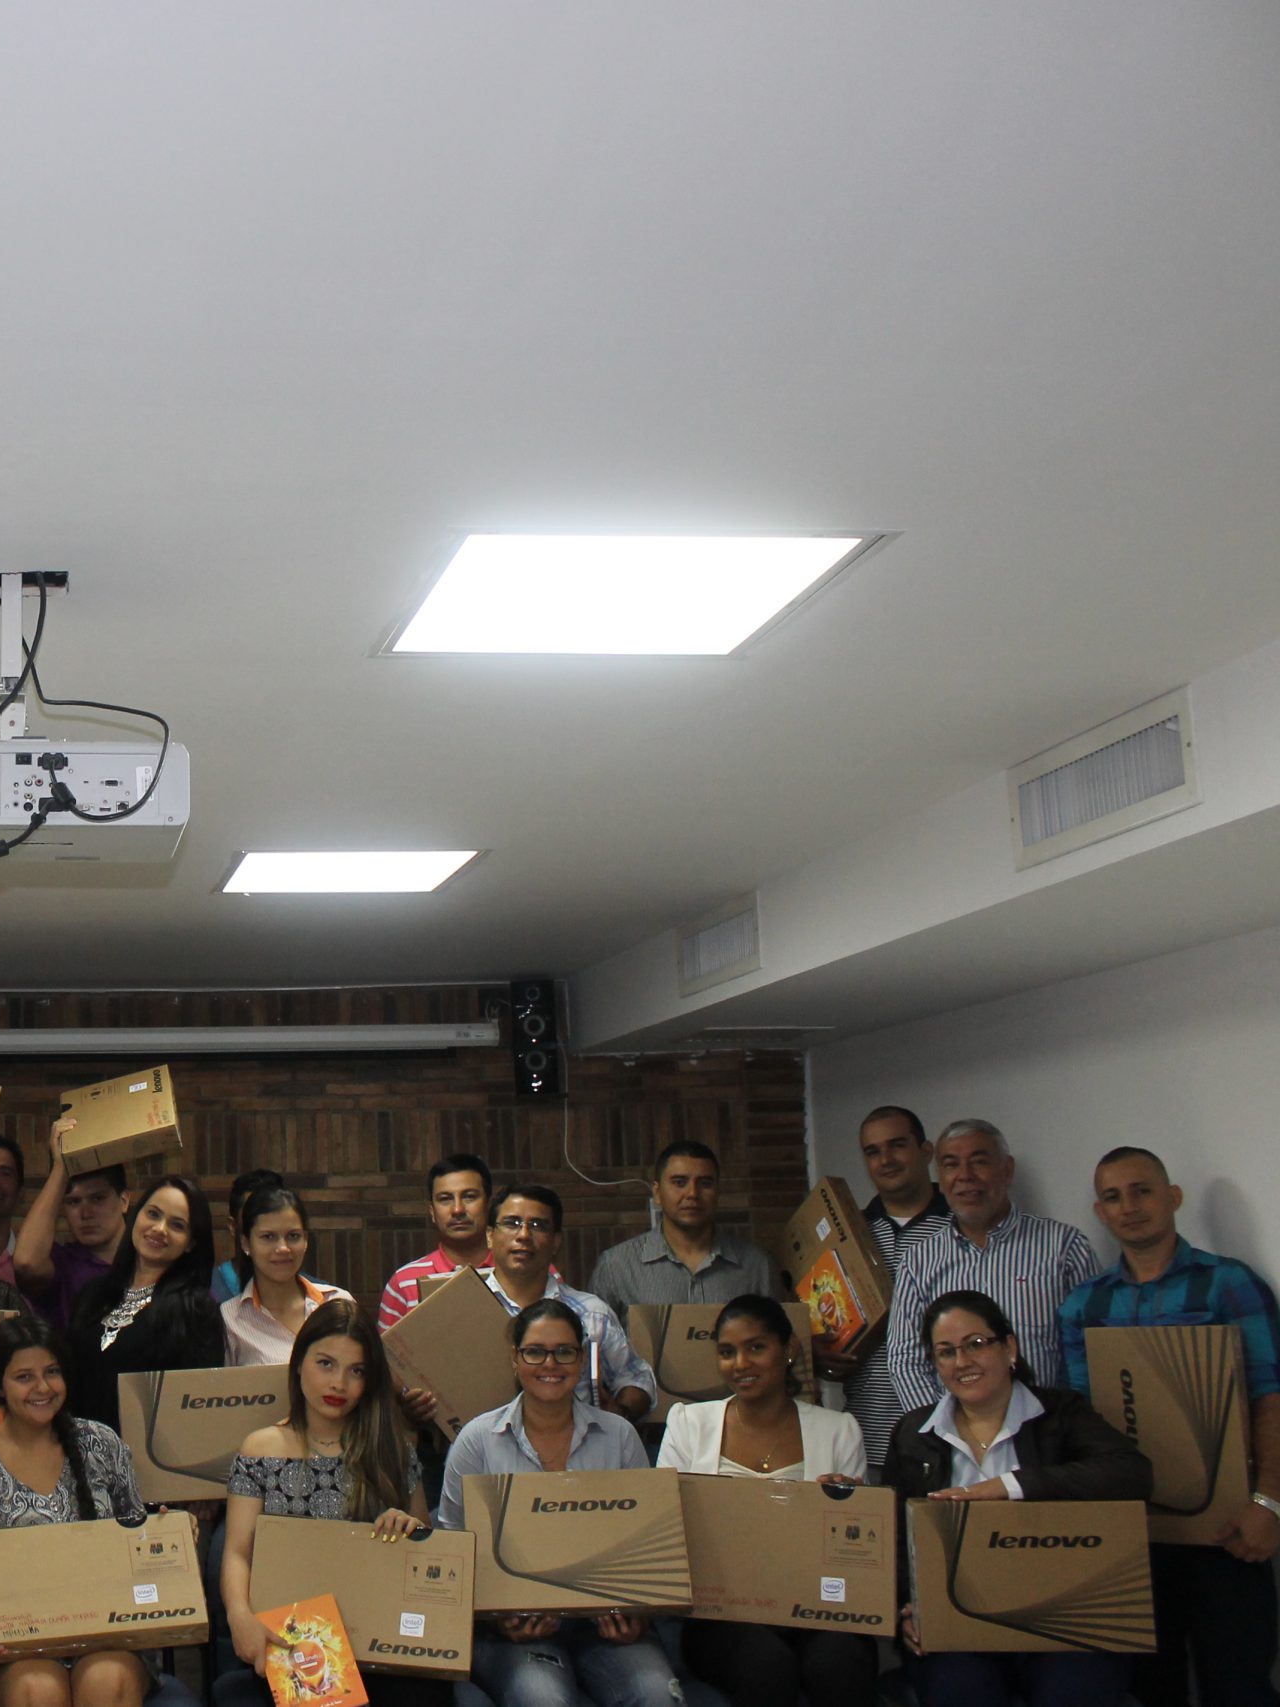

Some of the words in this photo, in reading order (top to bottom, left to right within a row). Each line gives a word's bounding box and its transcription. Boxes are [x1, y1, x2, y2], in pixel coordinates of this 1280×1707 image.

[820, 1188, 847, 1242] lenovo
[181, 1392, 276, 1410] lenovo
[531, 1497, 637, 1513] lenovo
[988, 1531, 1102, 1549] lenovo
[108, 1607, 196, 1623] lenovo
[791, 1604, 883, 1625] lenovo
[368, 1638, 459, 1660] lenovo
